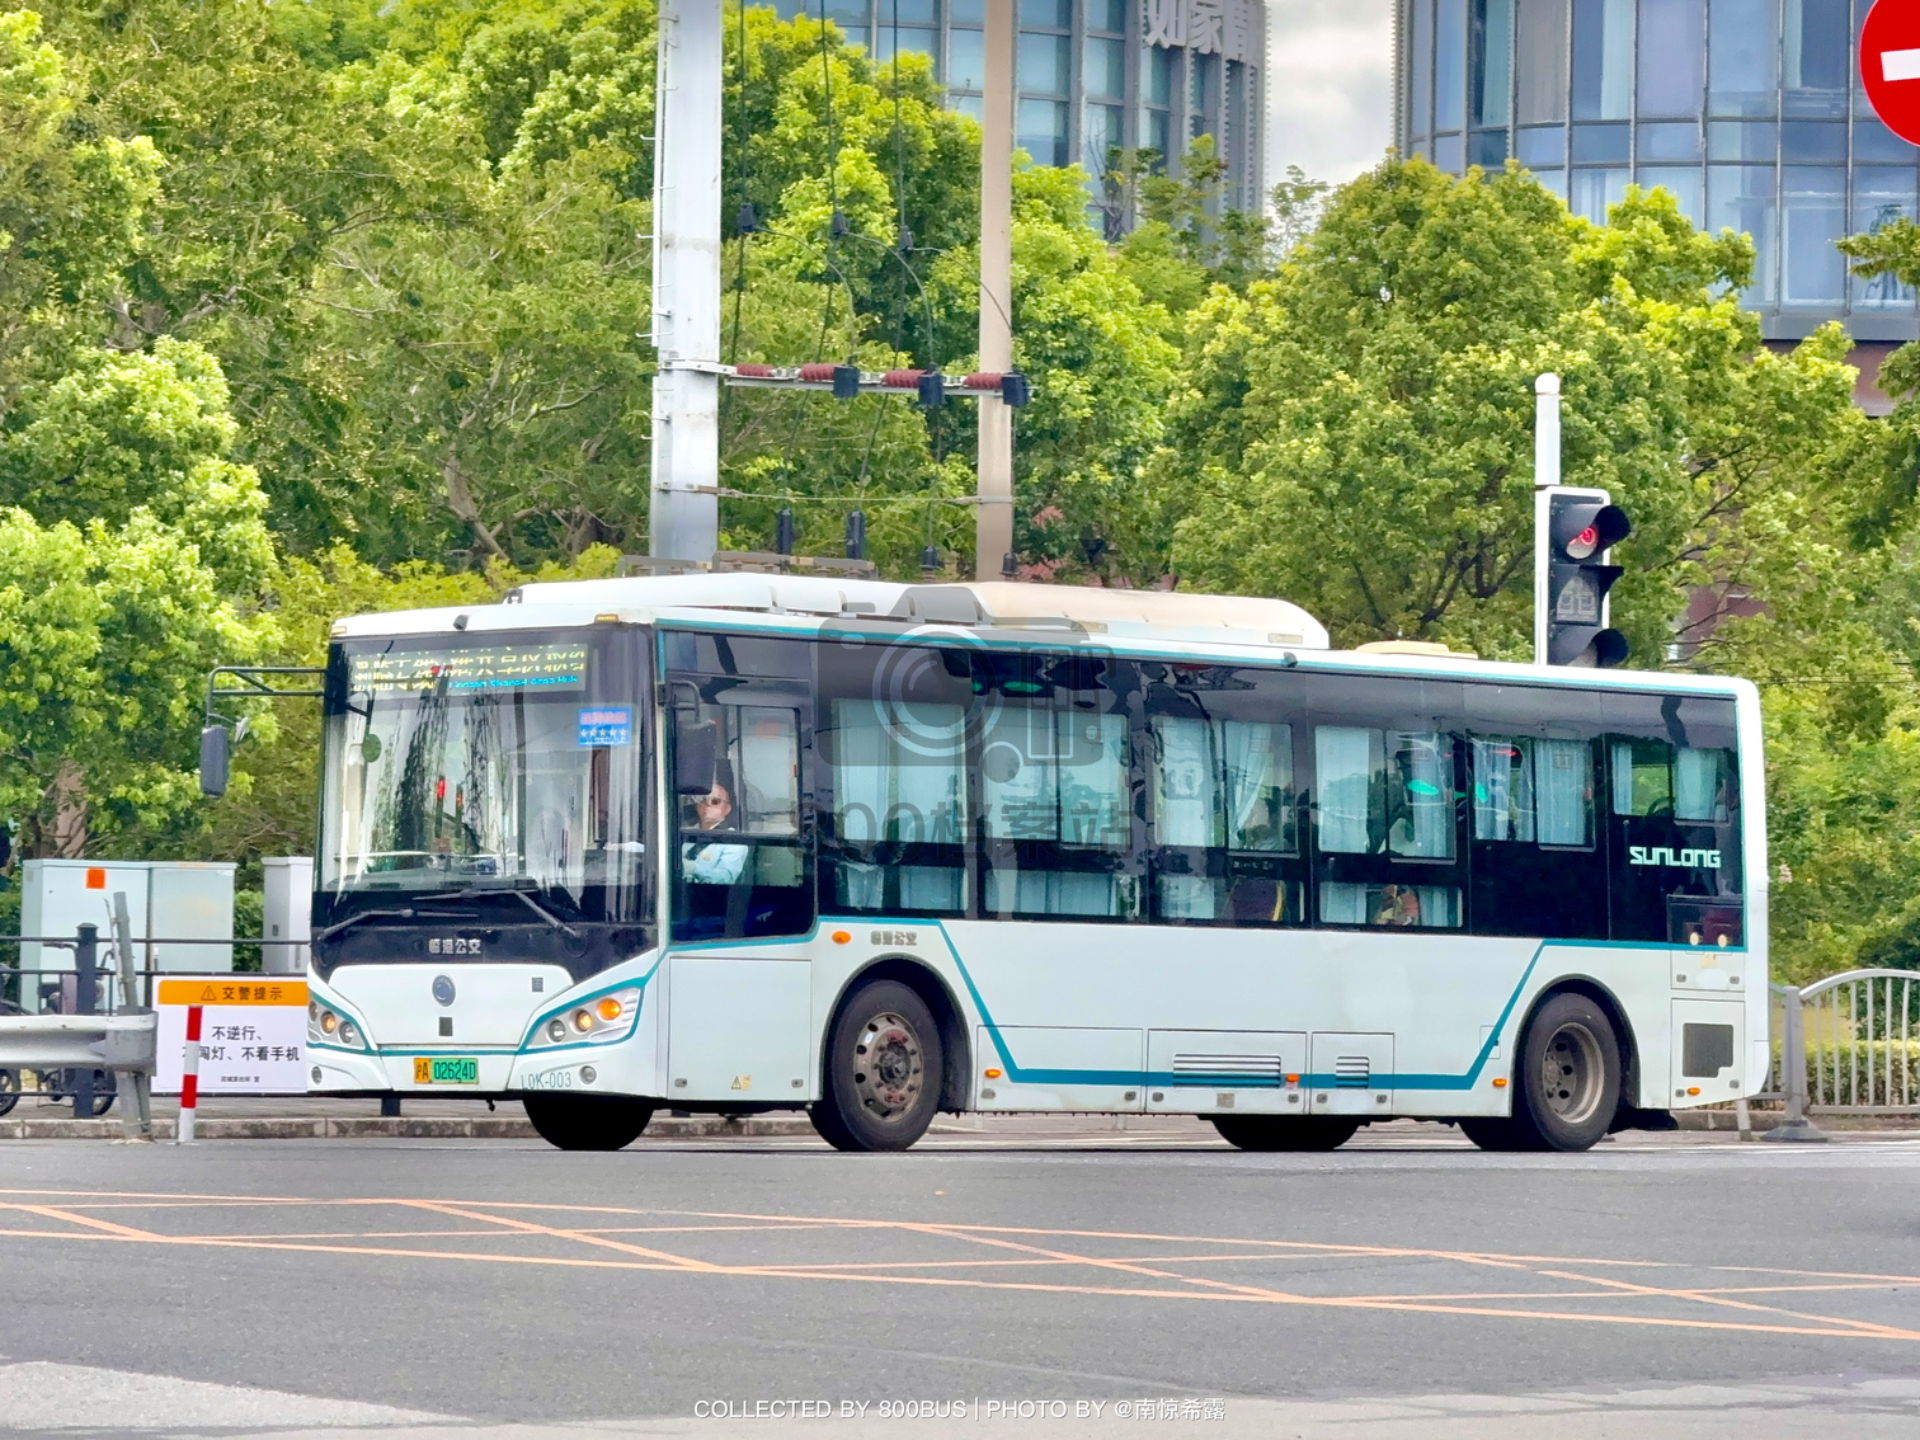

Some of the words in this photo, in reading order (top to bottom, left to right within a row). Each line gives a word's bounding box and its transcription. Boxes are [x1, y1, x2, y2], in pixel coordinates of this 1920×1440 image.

[1629, 846, 1722, 868] SUNLONG
[222, 986, 283, 1000] 交警提示
